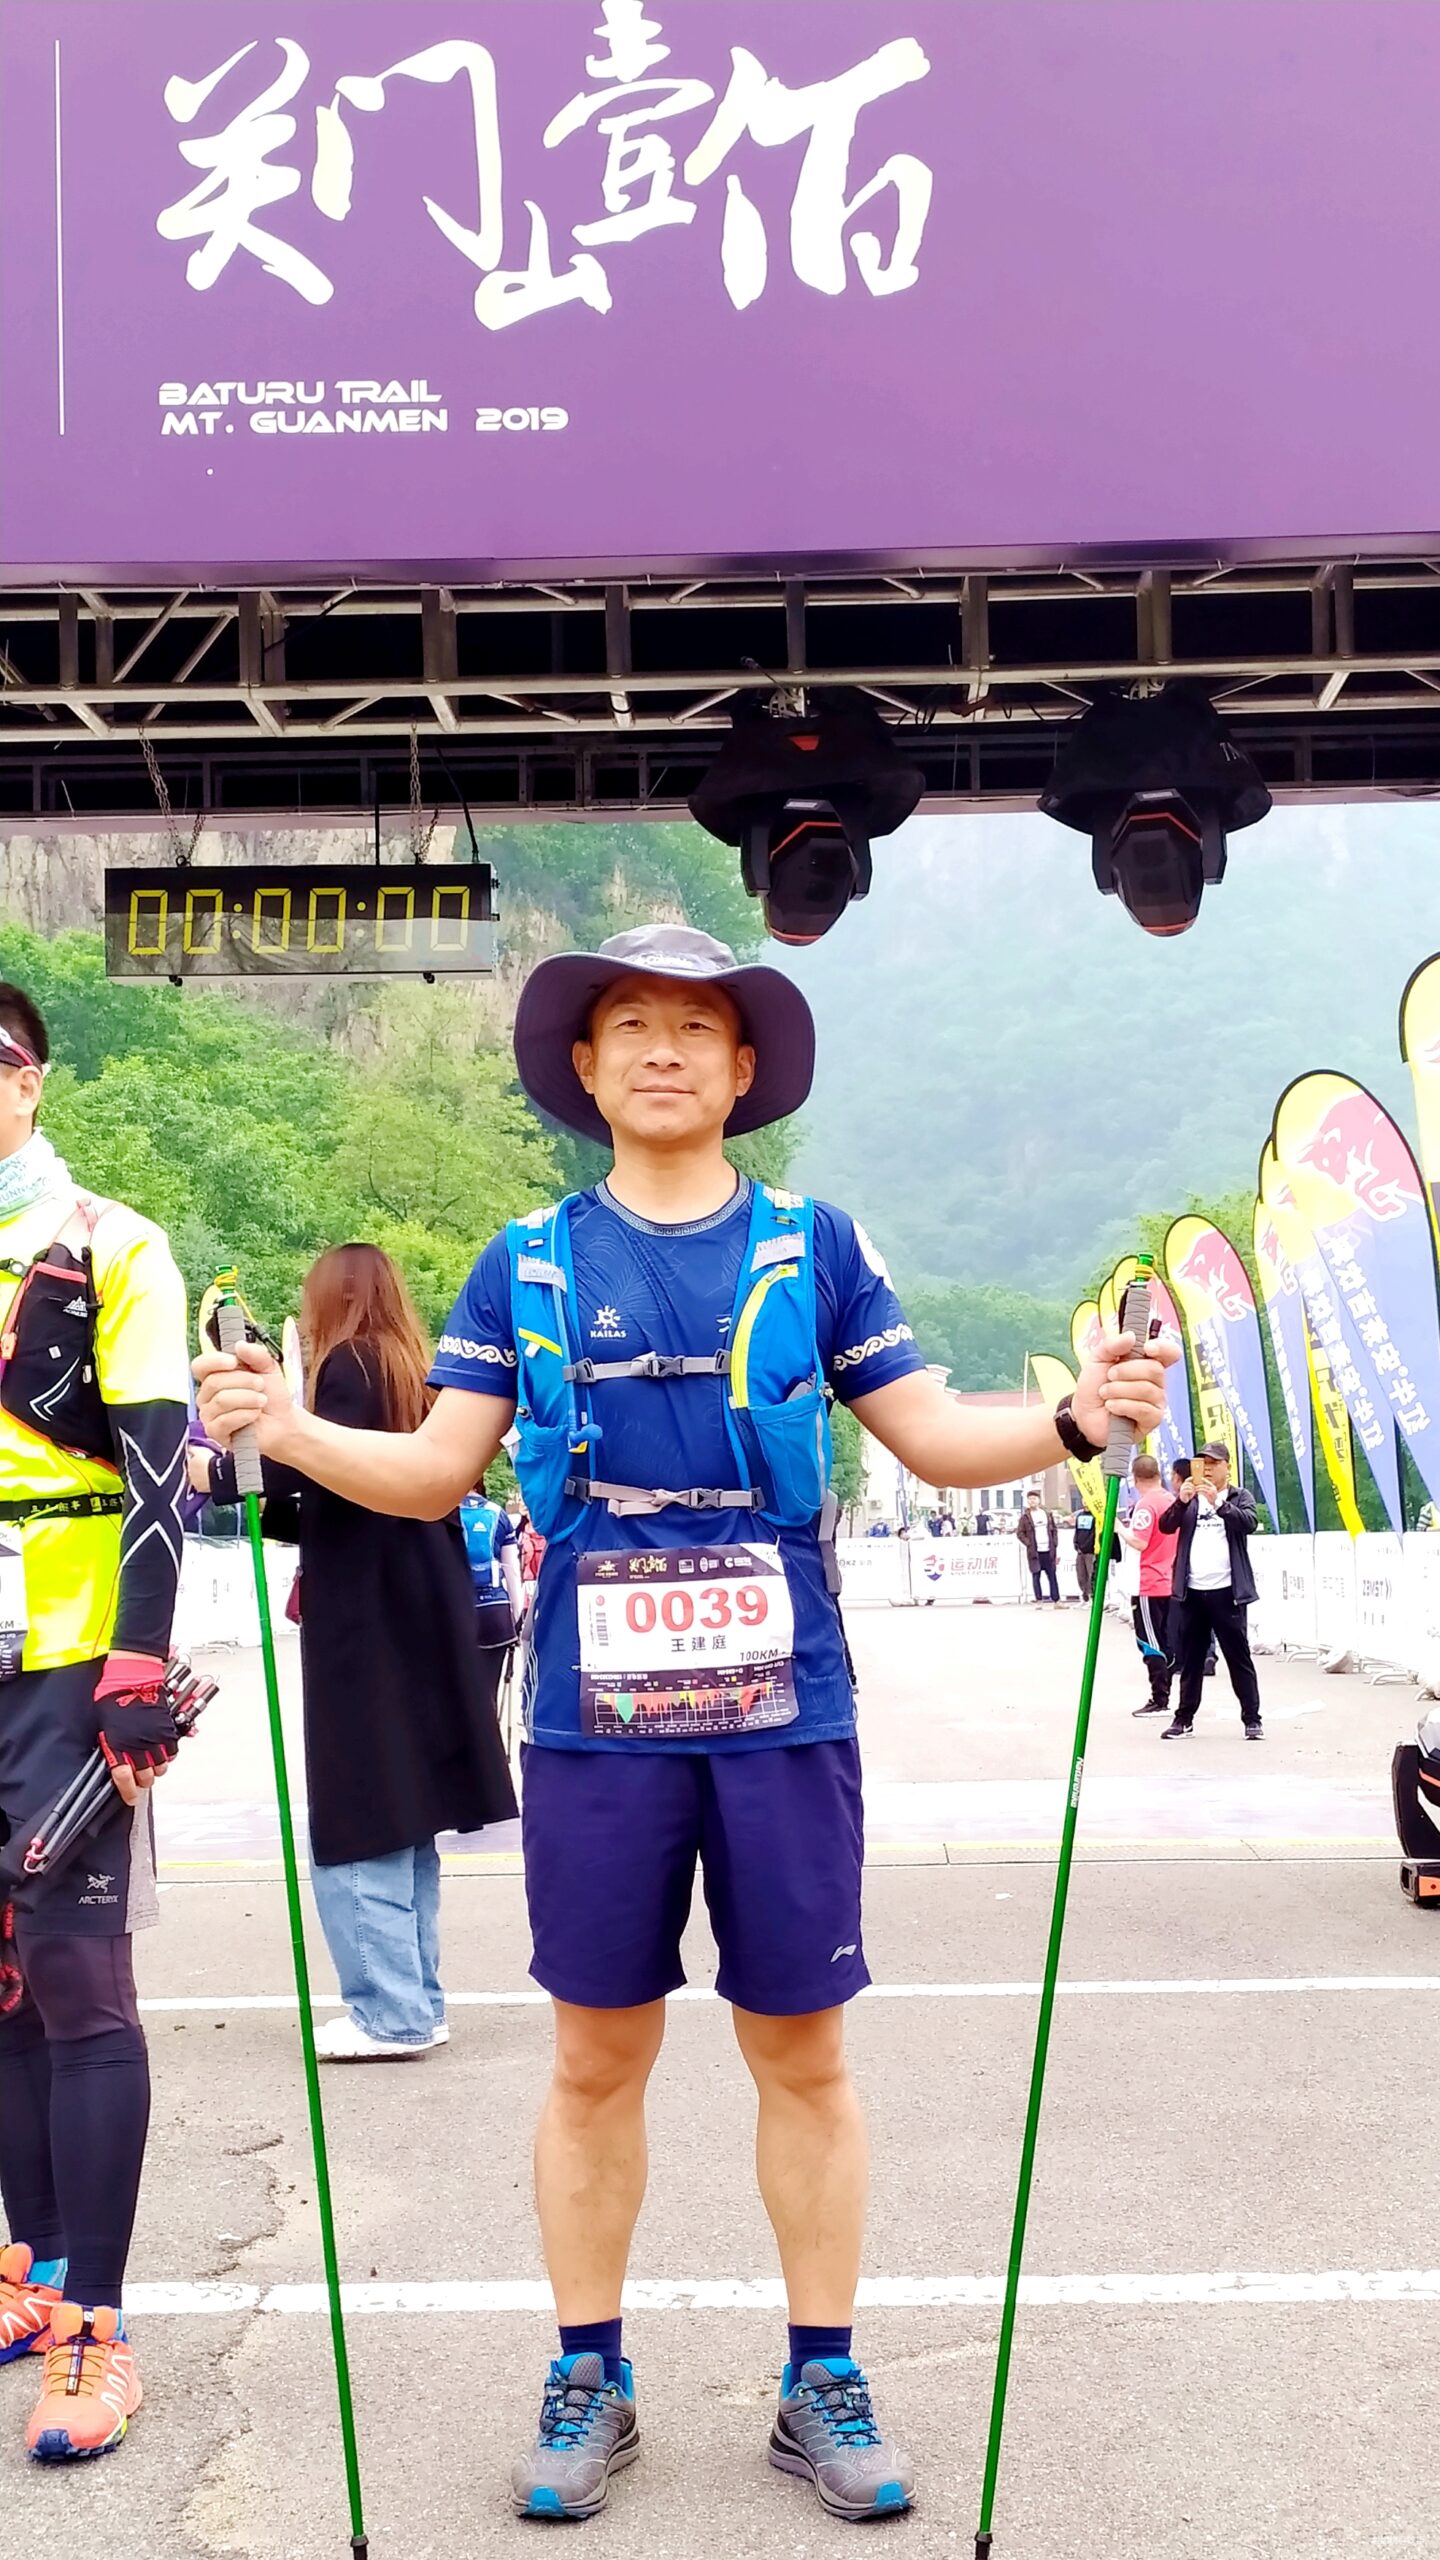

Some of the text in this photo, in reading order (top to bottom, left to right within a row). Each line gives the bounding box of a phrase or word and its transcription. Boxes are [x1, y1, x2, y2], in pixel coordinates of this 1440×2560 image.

[158, 379, 442, 406] BATURU TRAIL
[161, 407, 569, 435] MT. GUANMEN 2019
[128, 885, 471, 955] 00:00:00
[590, 1330, 626, 1338] KAILAS
[951, 1556, 998, 1570] 运动保
[626, 1585, 769, 1633] 0039
[671, 1635, 727, 1652] 王建庭
[740, 1648, 778, 1662] 100KM
